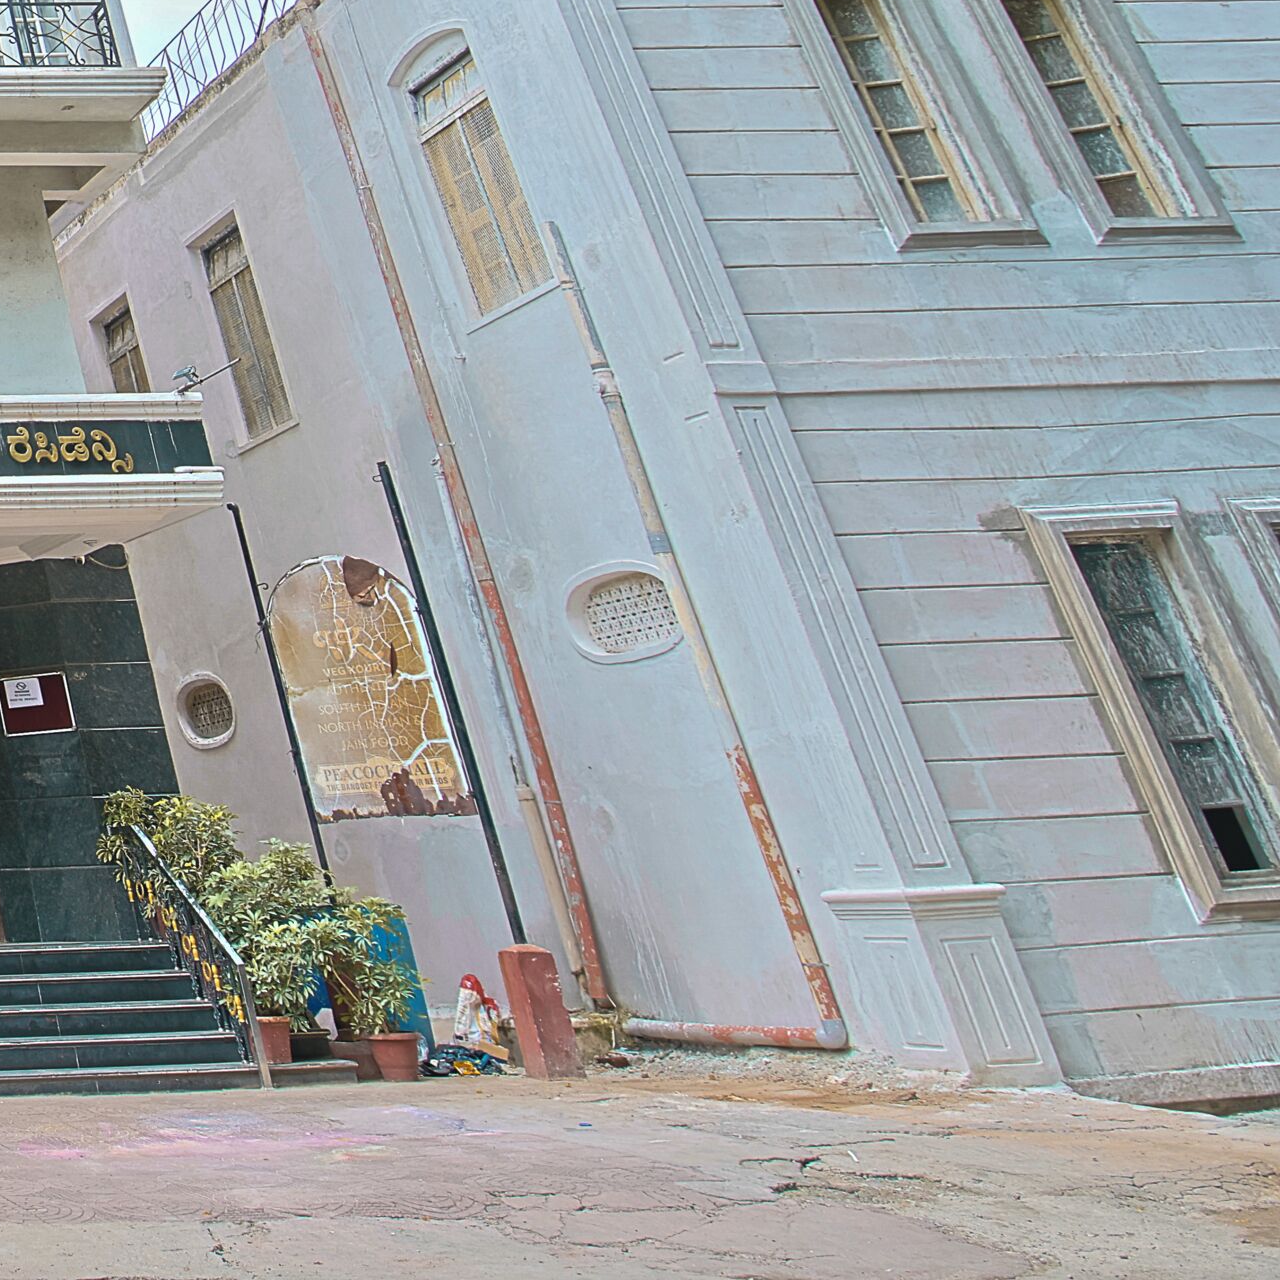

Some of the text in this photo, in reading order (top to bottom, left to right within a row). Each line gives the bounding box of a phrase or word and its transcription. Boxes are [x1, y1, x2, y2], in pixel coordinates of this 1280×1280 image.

[7, 426, 134, 473] ರೆಸಿಡೆನ್ಸಿ
[322, 665, 345, 678] VEG
[318, 702, 361, 716] SOUTH
[317, 720, 361, 735] NORTH
[365, 717, 410, 731] INDIAN
[342, 735, 409, 751] JAIN FOOD
